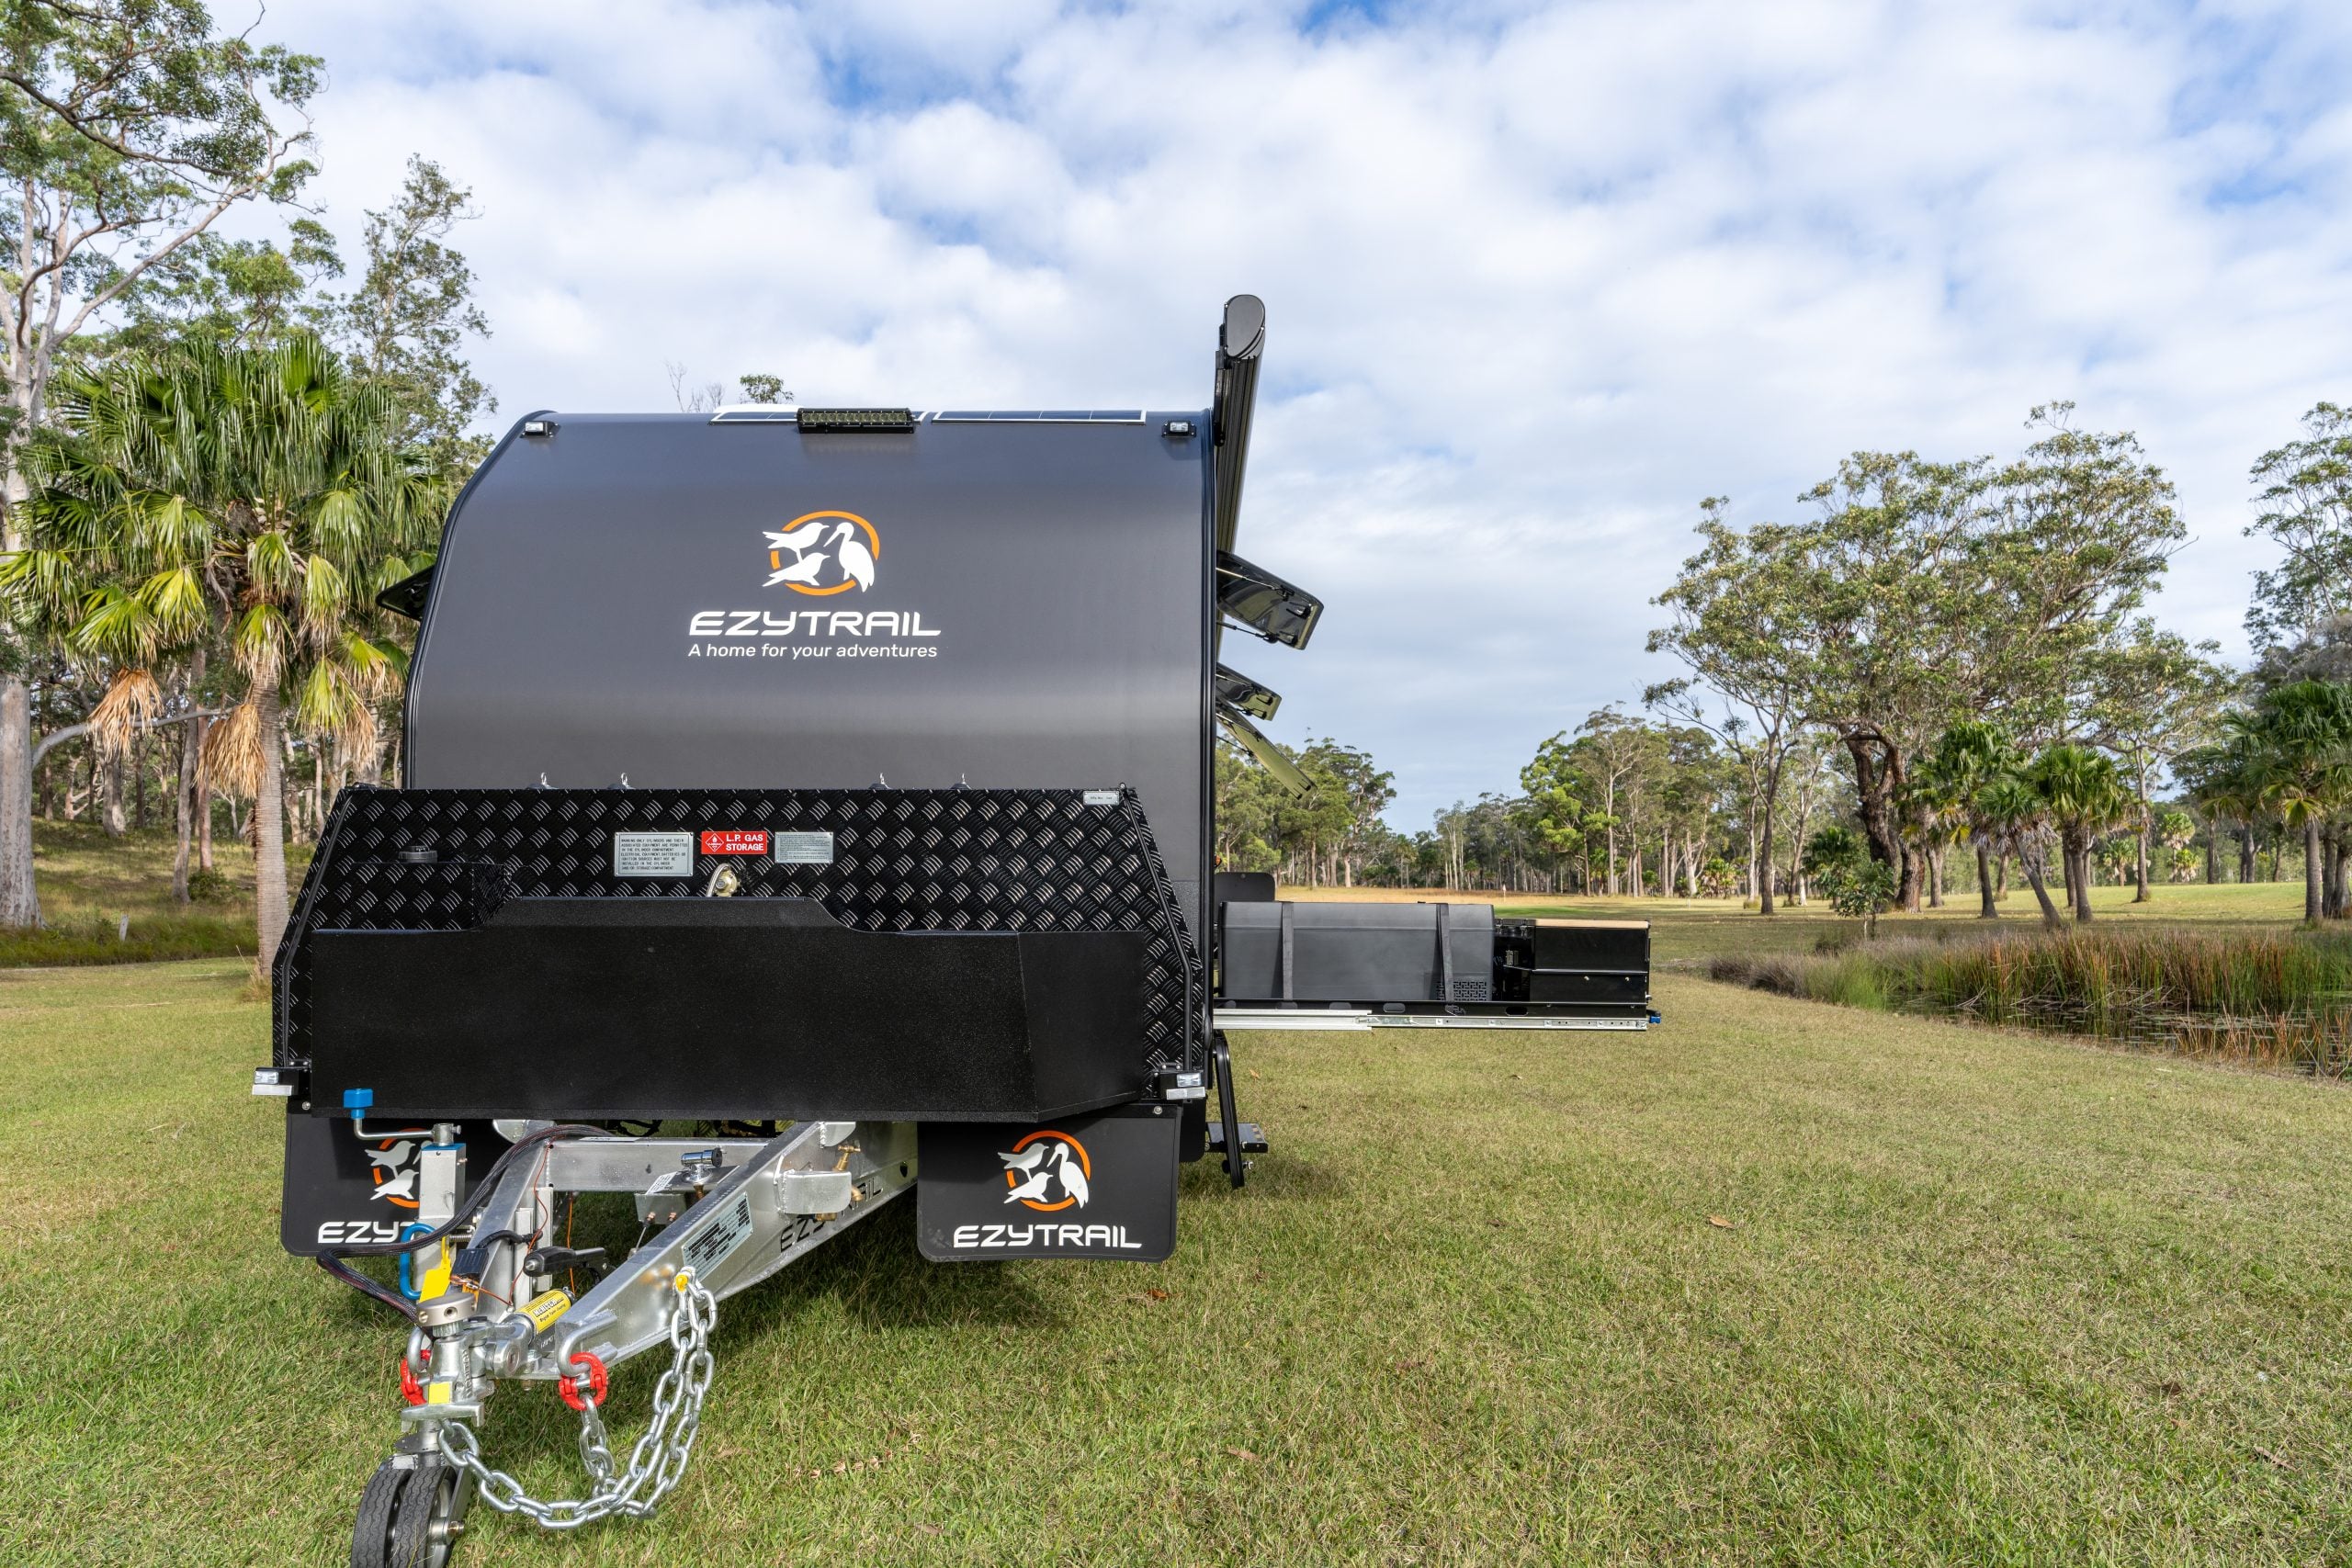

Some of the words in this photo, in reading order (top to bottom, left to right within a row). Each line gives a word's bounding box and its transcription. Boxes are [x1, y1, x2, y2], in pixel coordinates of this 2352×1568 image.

[689, 611, 942, 637] EZYTRAIL
[688, 644, 701, 658] A
[706, 643, 756, 658] home
[762, 643, 787, 658] for
[792, 645, 831, 660] your
[836, 643, 938, 658] adventures
[744, 834, 763, 842] GAS
[726, 843, 764, 852] STORAGE
[954, 1224, 1142, 1248] EZYTRAIL
